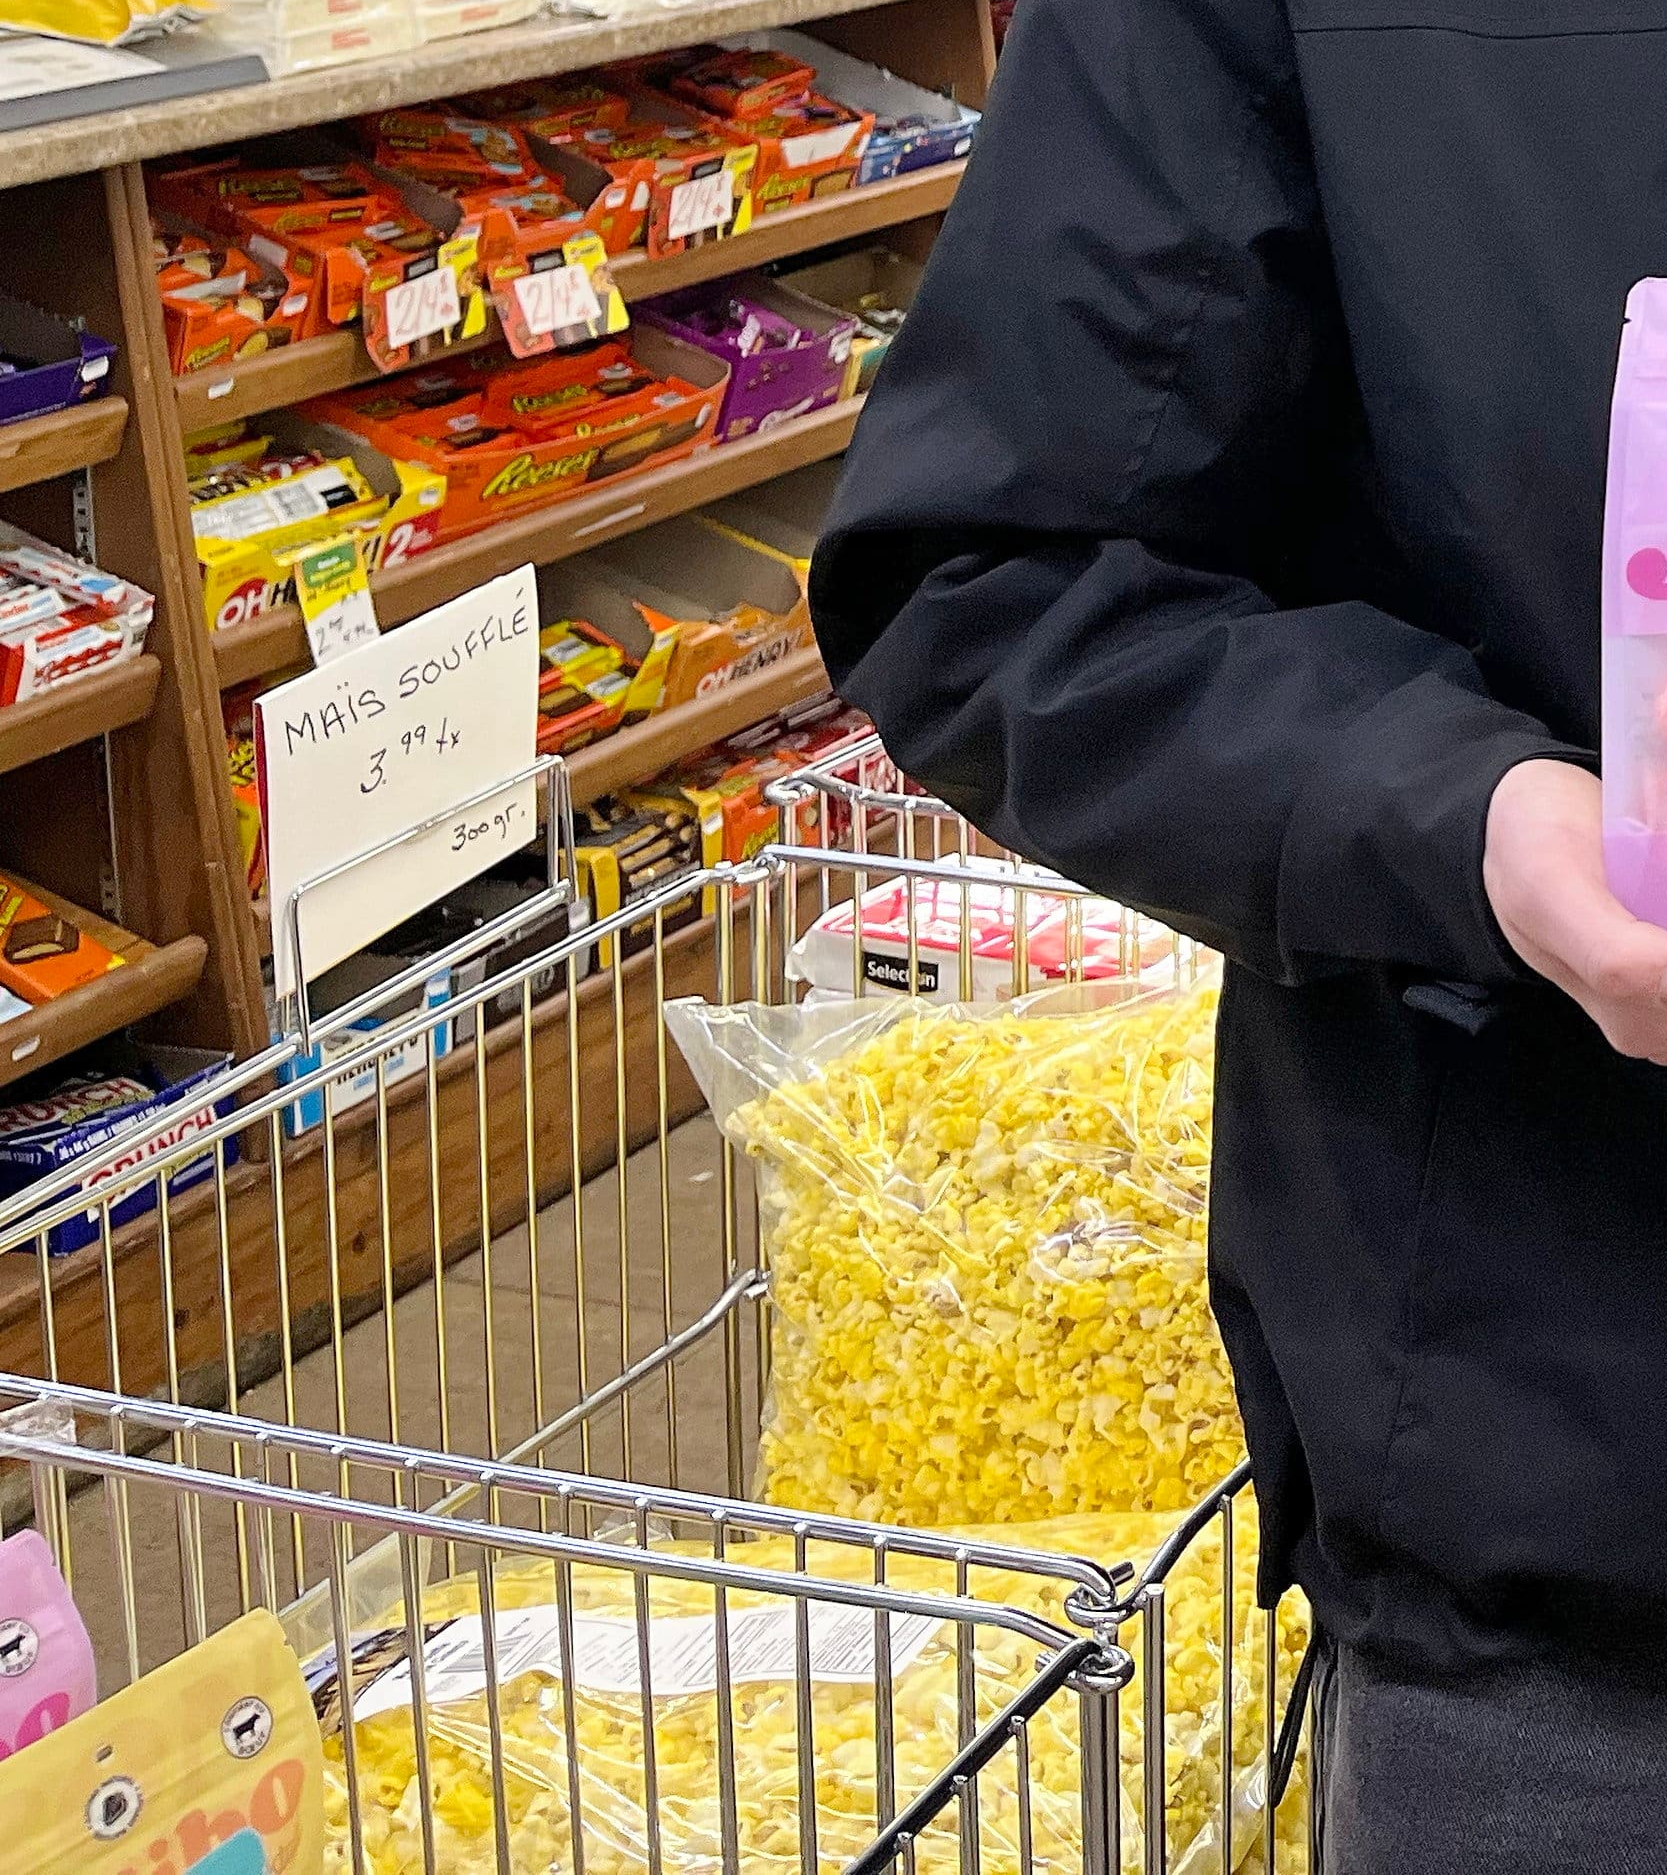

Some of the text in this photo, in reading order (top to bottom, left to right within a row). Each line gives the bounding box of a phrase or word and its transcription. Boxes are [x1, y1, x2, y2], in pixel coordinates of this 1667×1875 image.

[284, 681, 387, 757] MAÏS
[398, 587, 530, 700] SOUFFLÉ
[0, 1075, 142, 1130] RUNCH
